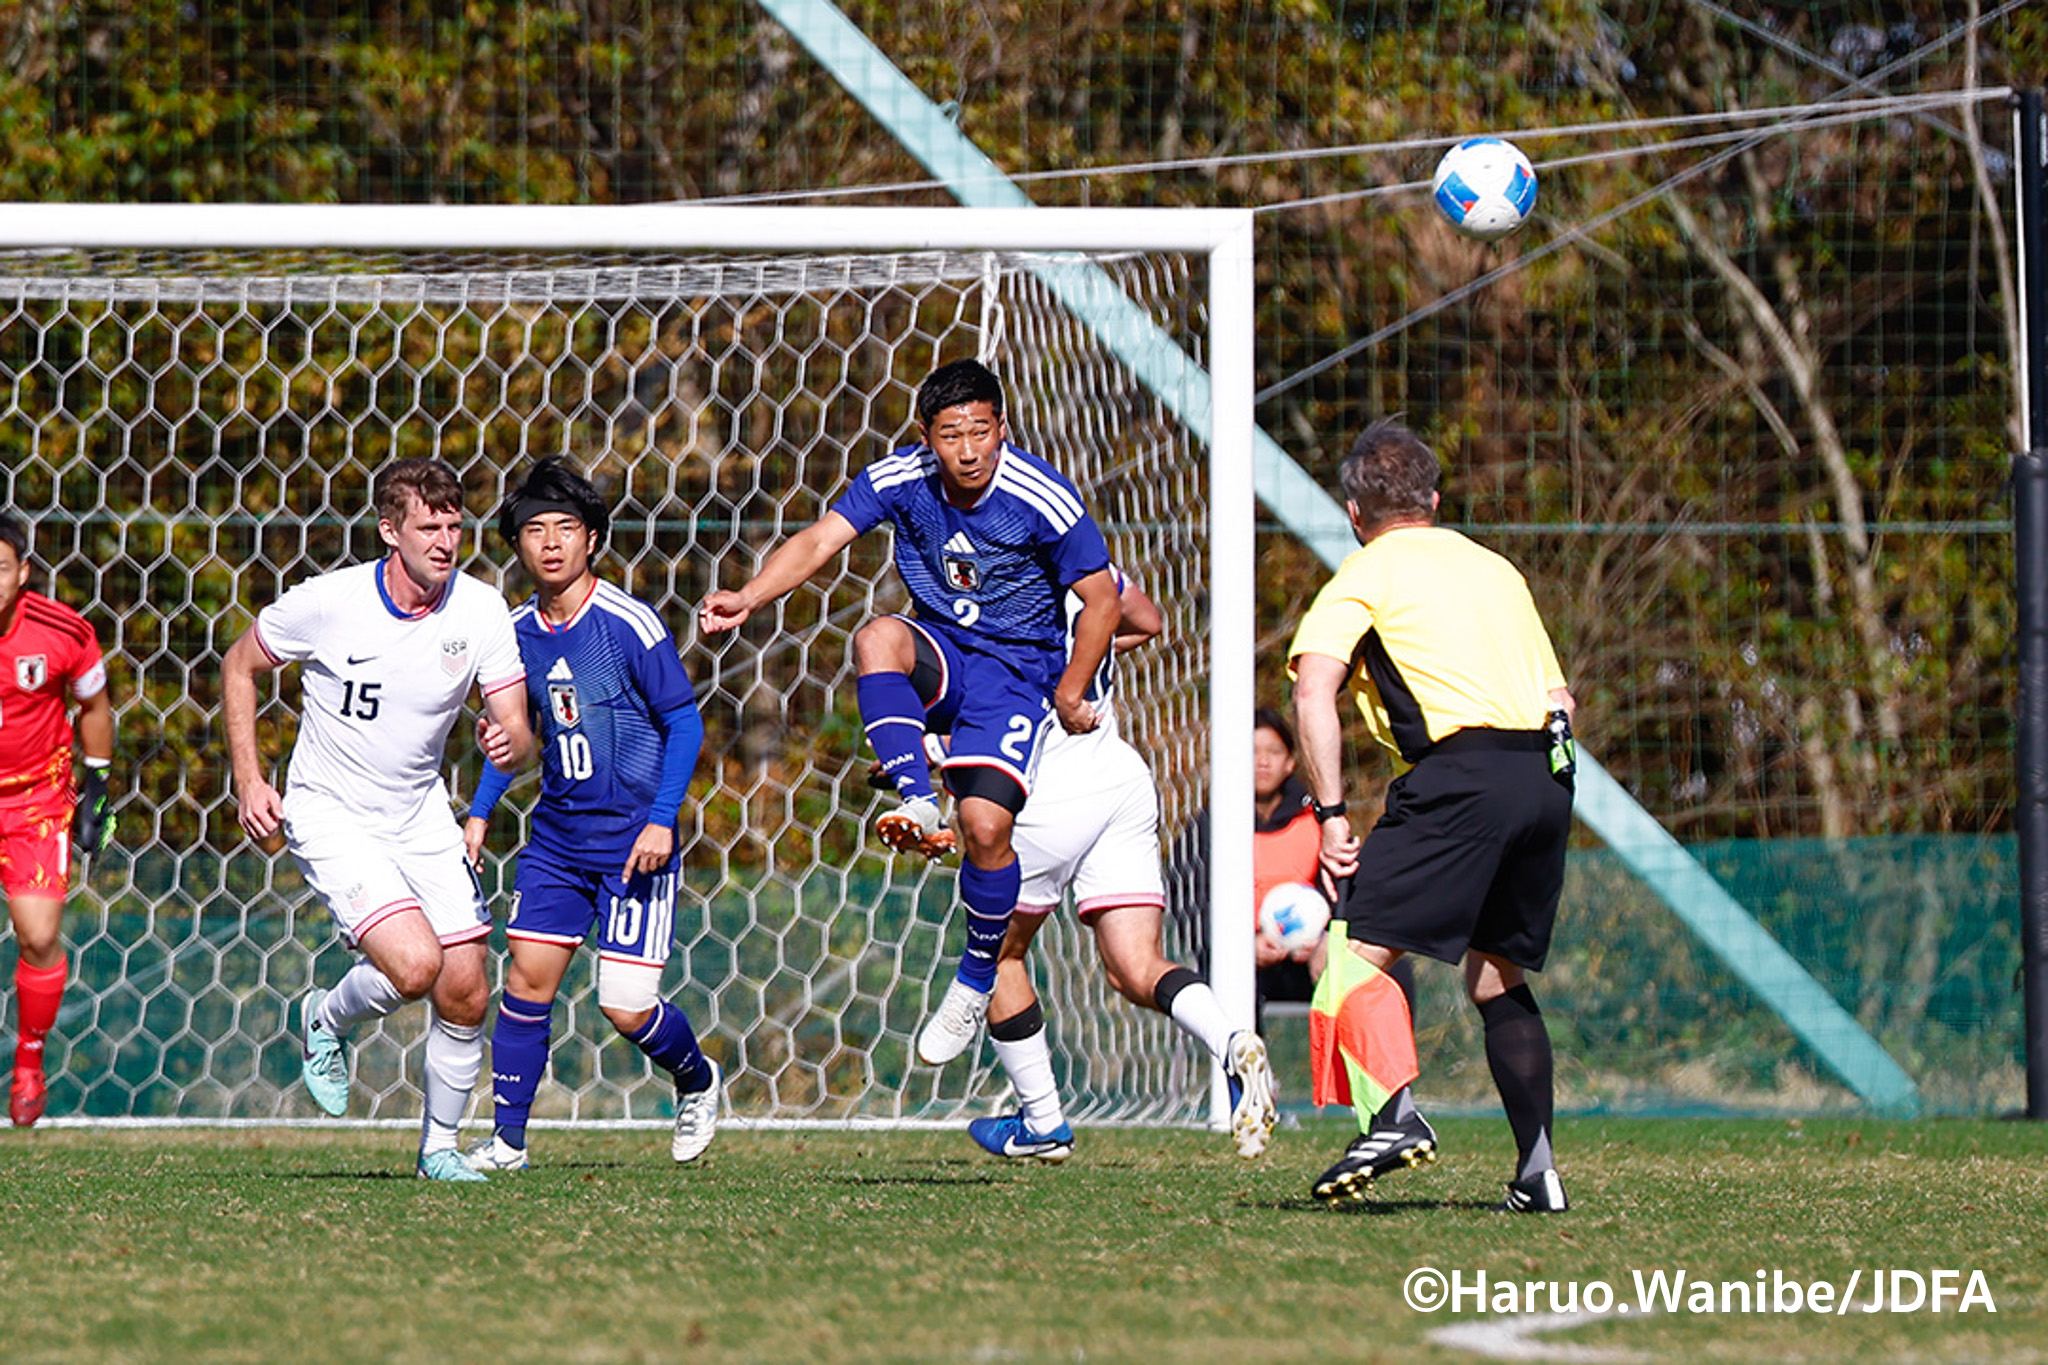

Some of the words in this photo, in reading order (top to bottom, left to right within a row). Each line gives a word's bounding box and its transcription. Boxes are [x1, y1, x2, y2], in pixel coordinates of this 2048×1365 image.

[953, 598, 980, 628] 2
[339, 680, 382, 721] 15
[557, 733, 595, 780] 10
[1000, 714, 1033, 762] 2
[606, 895, 643, 946] 10
